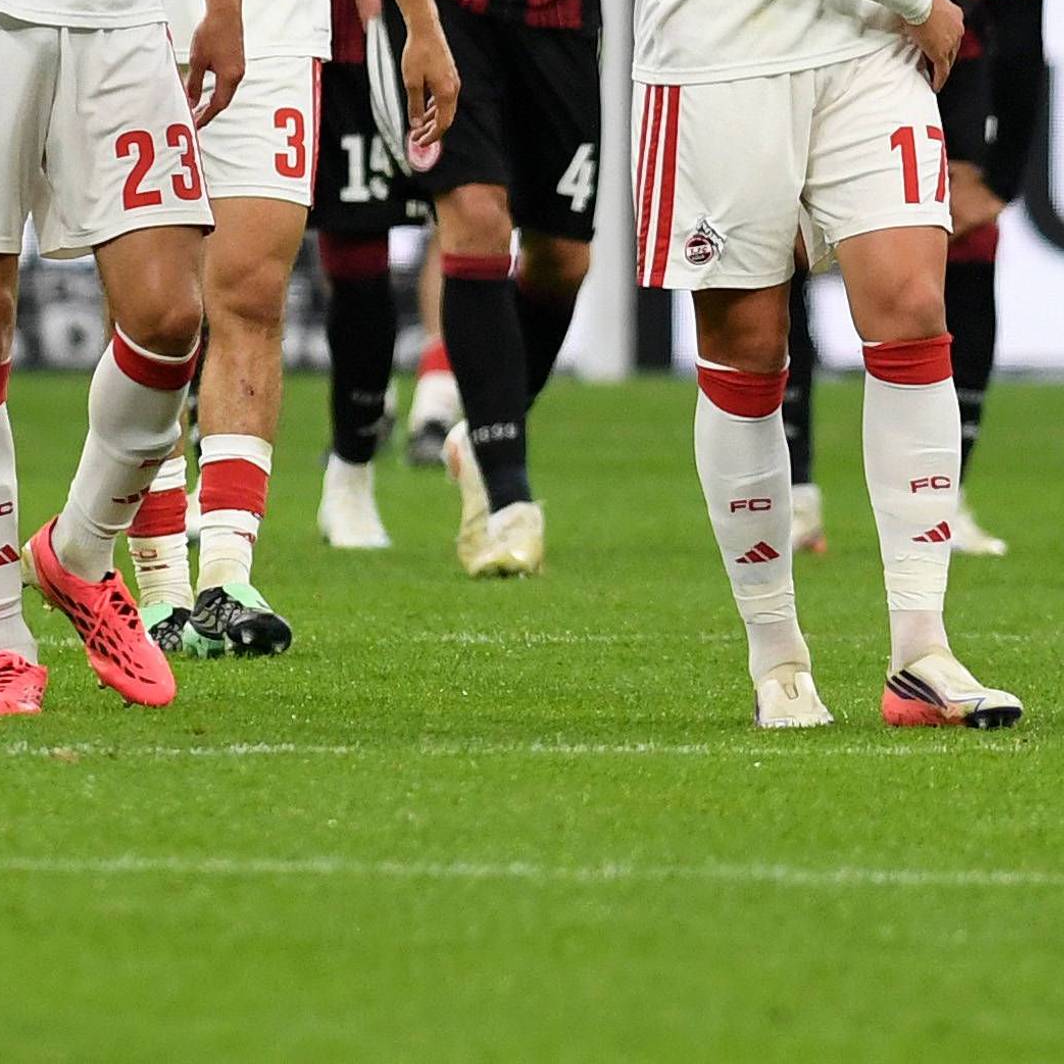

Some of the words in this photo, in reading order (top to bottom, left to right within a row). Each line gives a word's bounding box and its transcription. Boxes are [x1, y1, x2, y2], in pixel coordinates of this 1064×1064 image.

[115, 123, 203, 211] 23
[274, 107, 306, 178] 3
[555, 142, 598, 213] 4
[889, 125, 946, 204] 17
[730, 498, 772, 513] FC
[910, 476, 951, 494] FC
